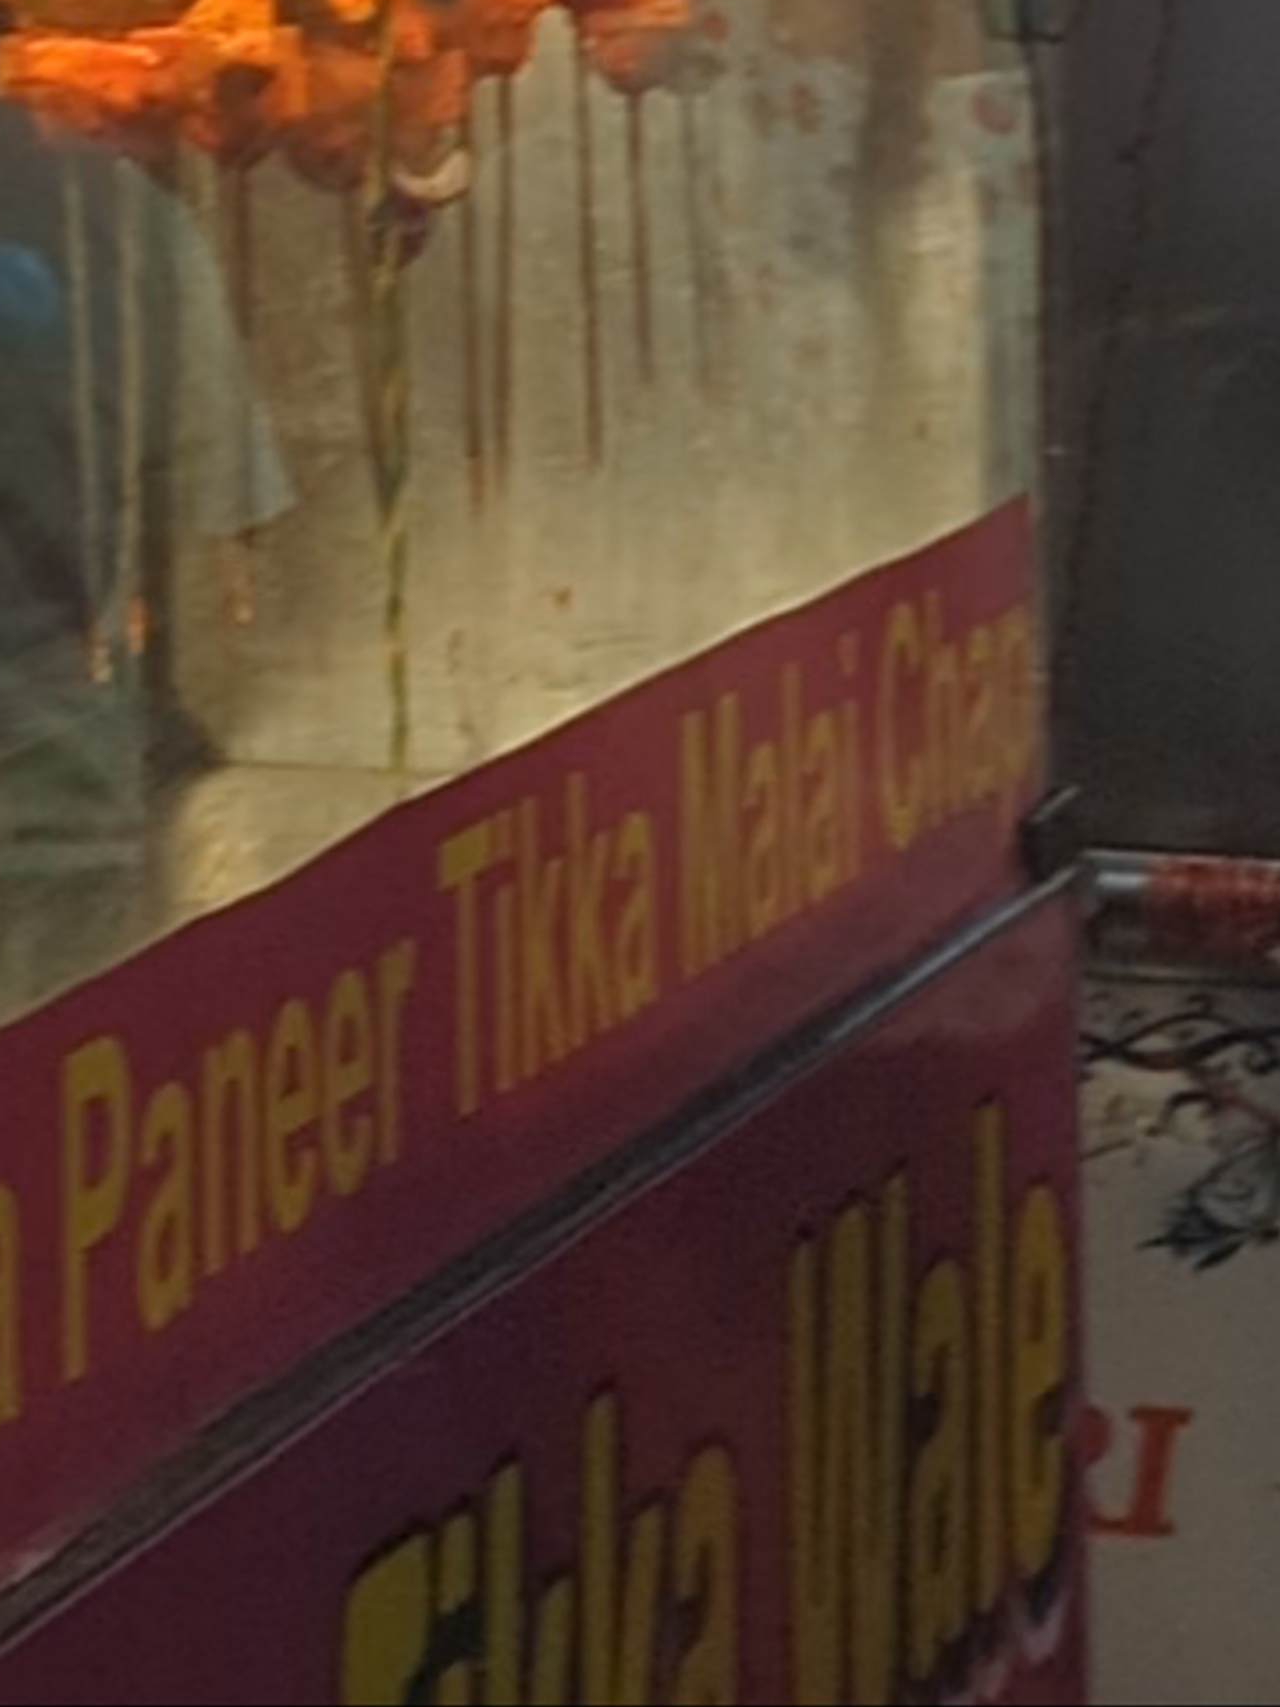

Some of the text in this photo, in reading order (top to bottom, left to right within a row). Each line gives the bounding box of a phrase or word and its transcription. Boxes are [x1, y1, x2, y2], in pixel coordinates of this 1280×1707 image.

[62, 938, 416, 1382] Paneer
[438, 770, 659, 1116] Tikka
[680, 630, 862, 978] Malai
[786, 1098, 1070, 1706] Wale
